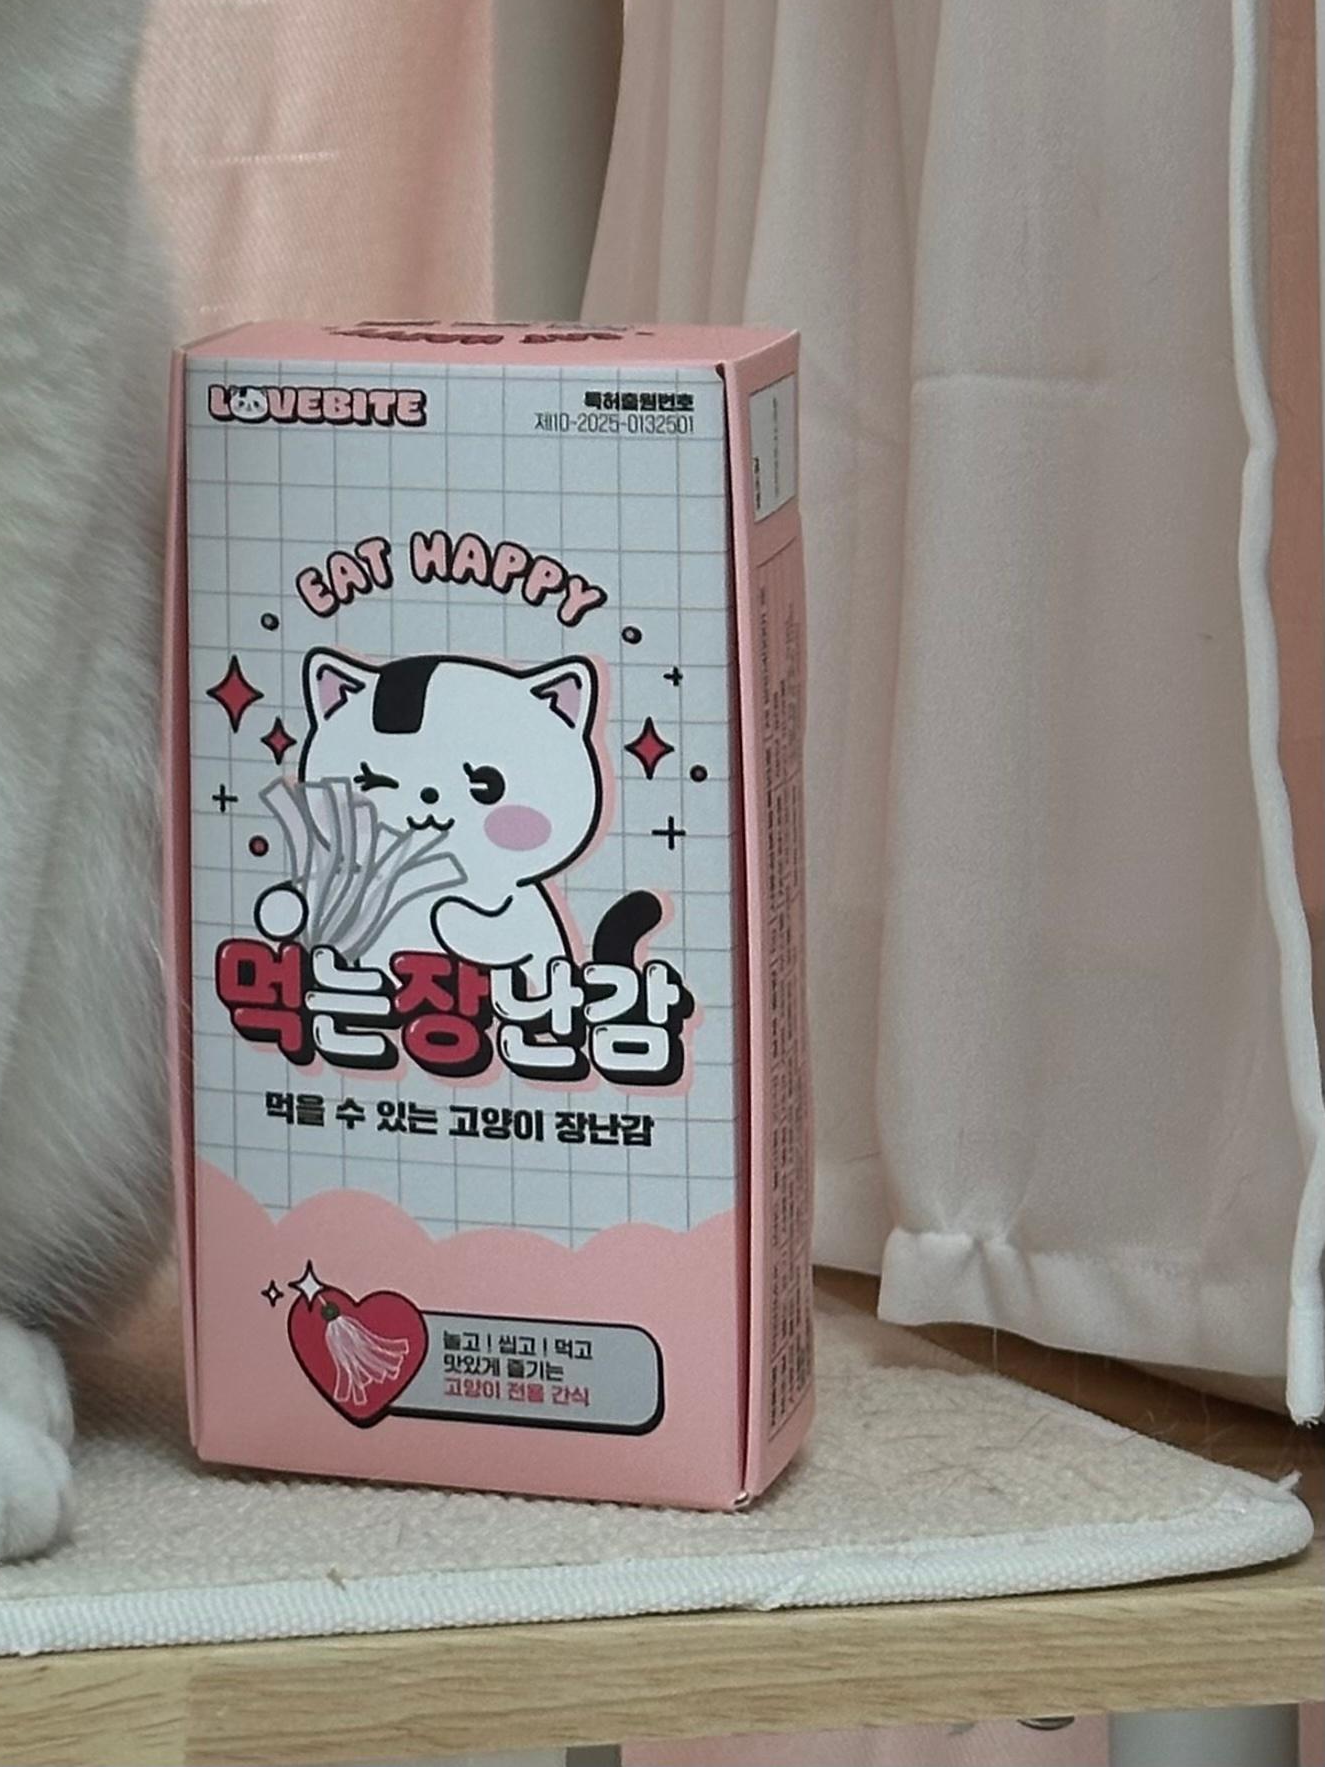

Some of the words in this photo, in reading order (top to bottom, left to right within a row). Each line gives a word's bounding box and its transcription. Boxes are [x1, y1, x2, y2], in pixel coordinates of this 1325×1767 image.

[534, 412, 694, 434] 제10-2025-0132501
[296, 537, 392, 618] EAT
[410, 530, 606, 625] HAPPY
[215, 937, 694, 1086] 먹는장난감
[265, 1091, 325, 1127] 먹을
[336, 1098, 366, 1130] 수
[376, 1100, 439, 1135] 있는
[448, 1105, 545, 1142] 고양이
[554, 1111, 656, 1147] 장난감
[498, 1335, 536, 1356] 씹고
[555, 1338, 593, 1360] 먹고
[443, 1353, 500, 1377] 맛있게
[507, 1359, 564, 1382] 즐기는
[443, 1377, 500, 1400] 고양이
[551, 1385, 590, 1408] 간식
